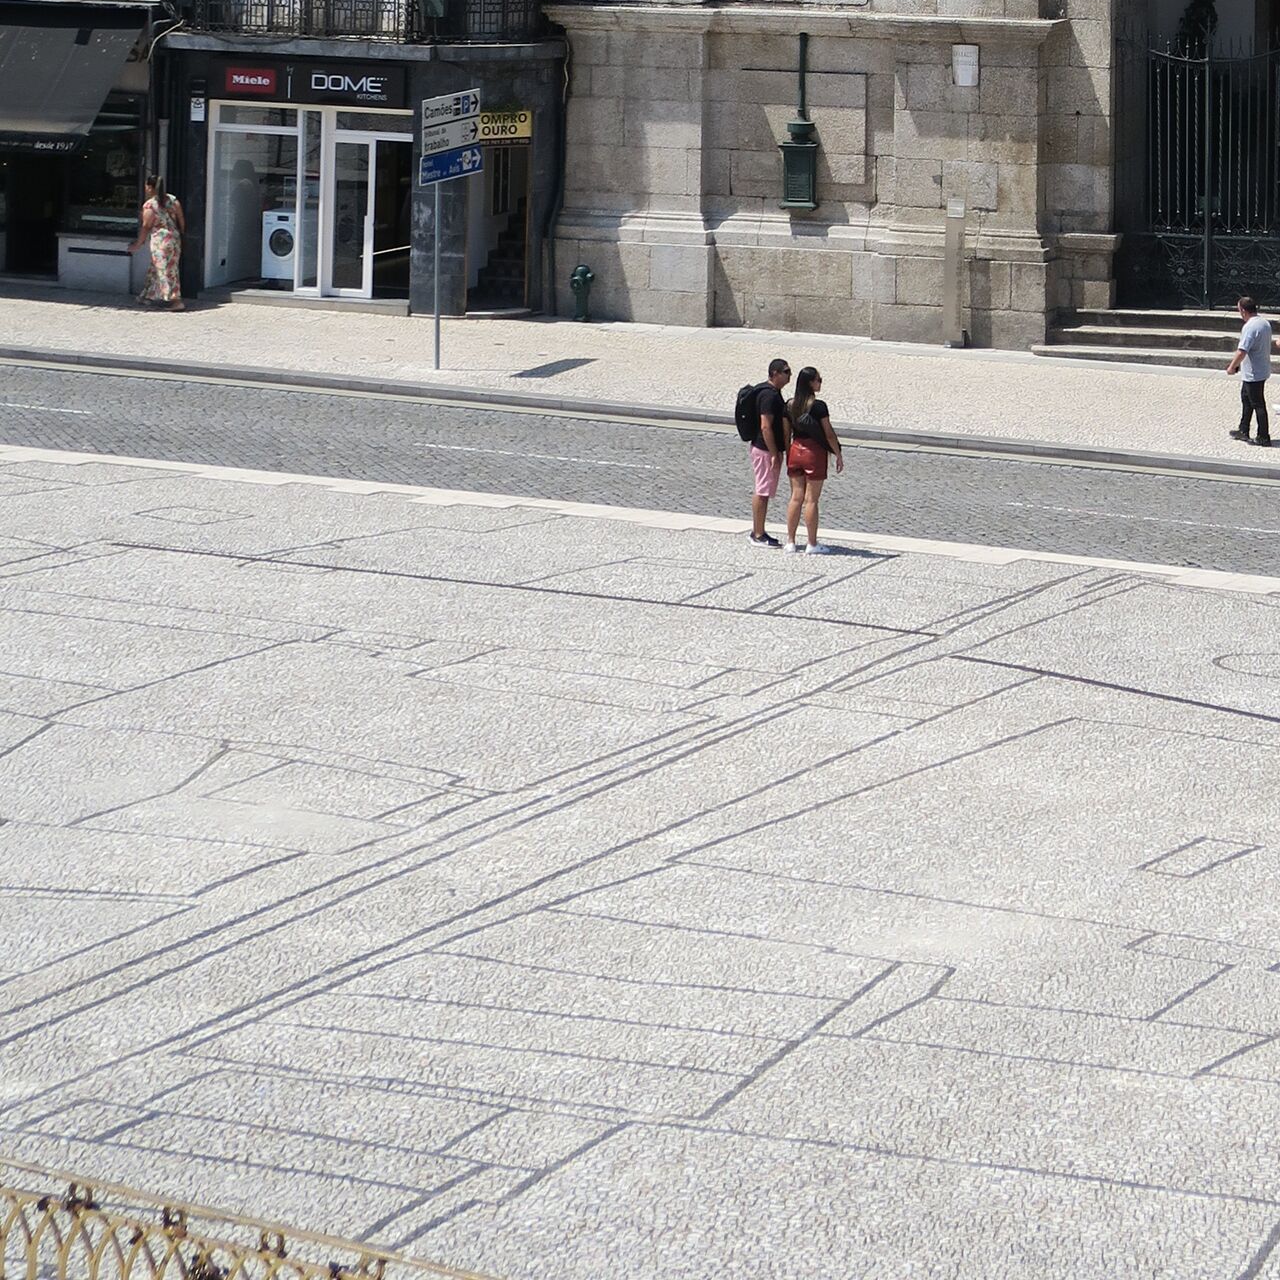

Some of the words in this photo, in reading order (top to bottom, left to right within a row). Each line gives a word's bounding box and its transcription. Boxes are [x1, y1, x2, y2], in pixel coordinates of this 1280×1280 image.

[232, 75, 270, 86] Miele
[311, 73, 382, 93] DOME
[357, 93, 388, 102] KITCHENS
[424, 103, 453, 120] Camões
[480, 113, 527, 125] OMPRO
[482, 125, 517, 136] OURO
